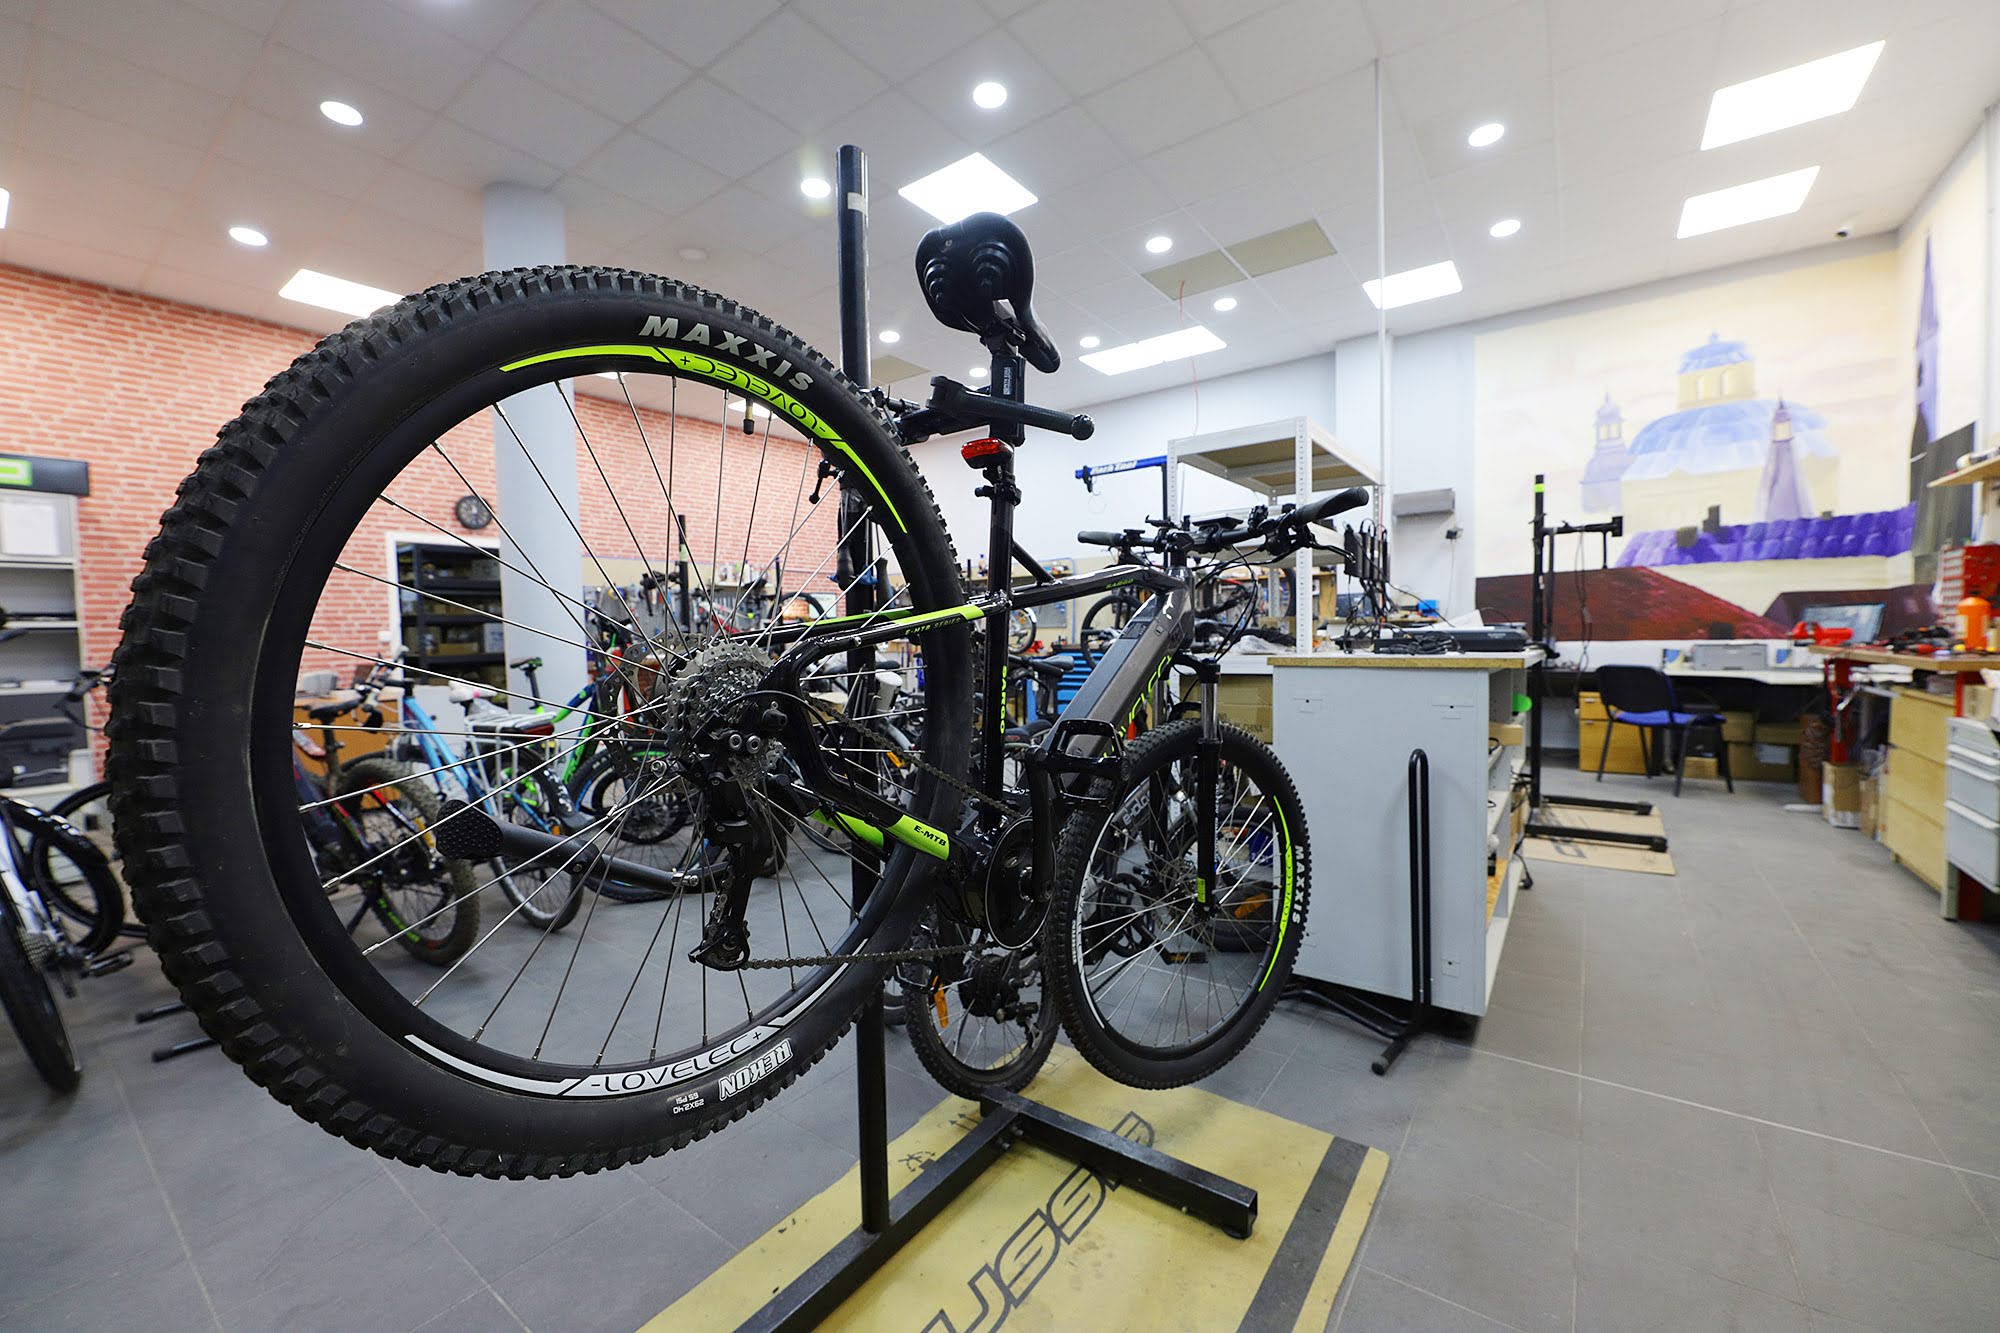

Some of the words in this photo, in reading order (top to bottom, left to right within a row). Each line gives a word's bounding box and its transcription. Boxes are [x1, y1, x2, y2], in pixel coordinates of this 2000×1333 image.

[638, 315, 814, 391] MAXXIS
[914, 825, 947, 846] E-MTB
[1292, 845, 1305, 924] MAXXIS
[675, 1095, 688, 1104] PSI
[718, 1038, 793, 1101] REKON
